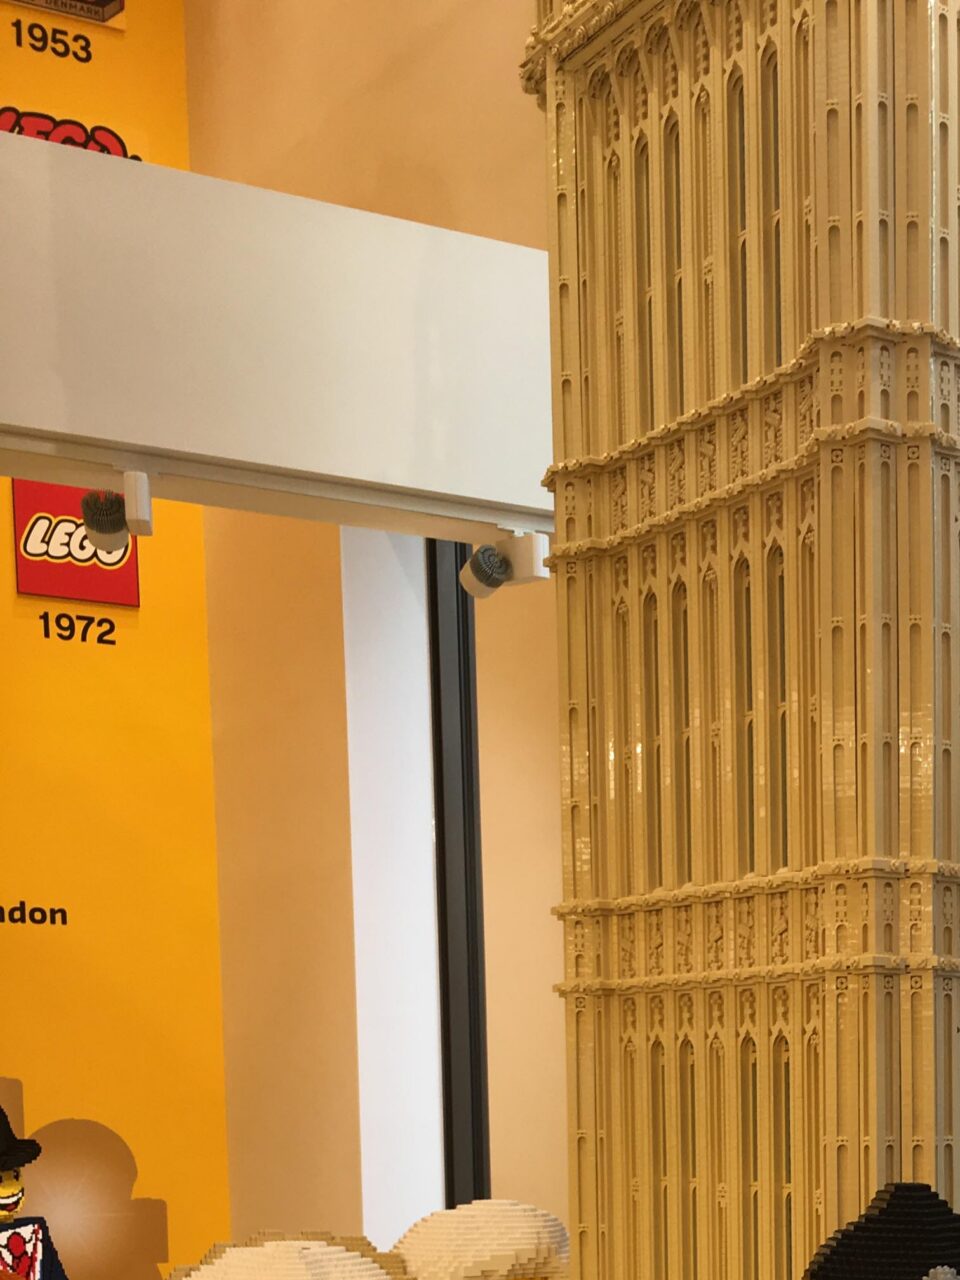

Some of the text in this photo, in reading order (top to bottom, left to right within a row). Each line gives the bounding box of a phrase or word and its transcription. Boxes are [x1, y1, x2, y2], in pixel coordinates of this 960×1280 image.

[11, 18, 93, 64] 1953
[38, 611, 117, 646] 1972
[0, 900, 68, 926] don
